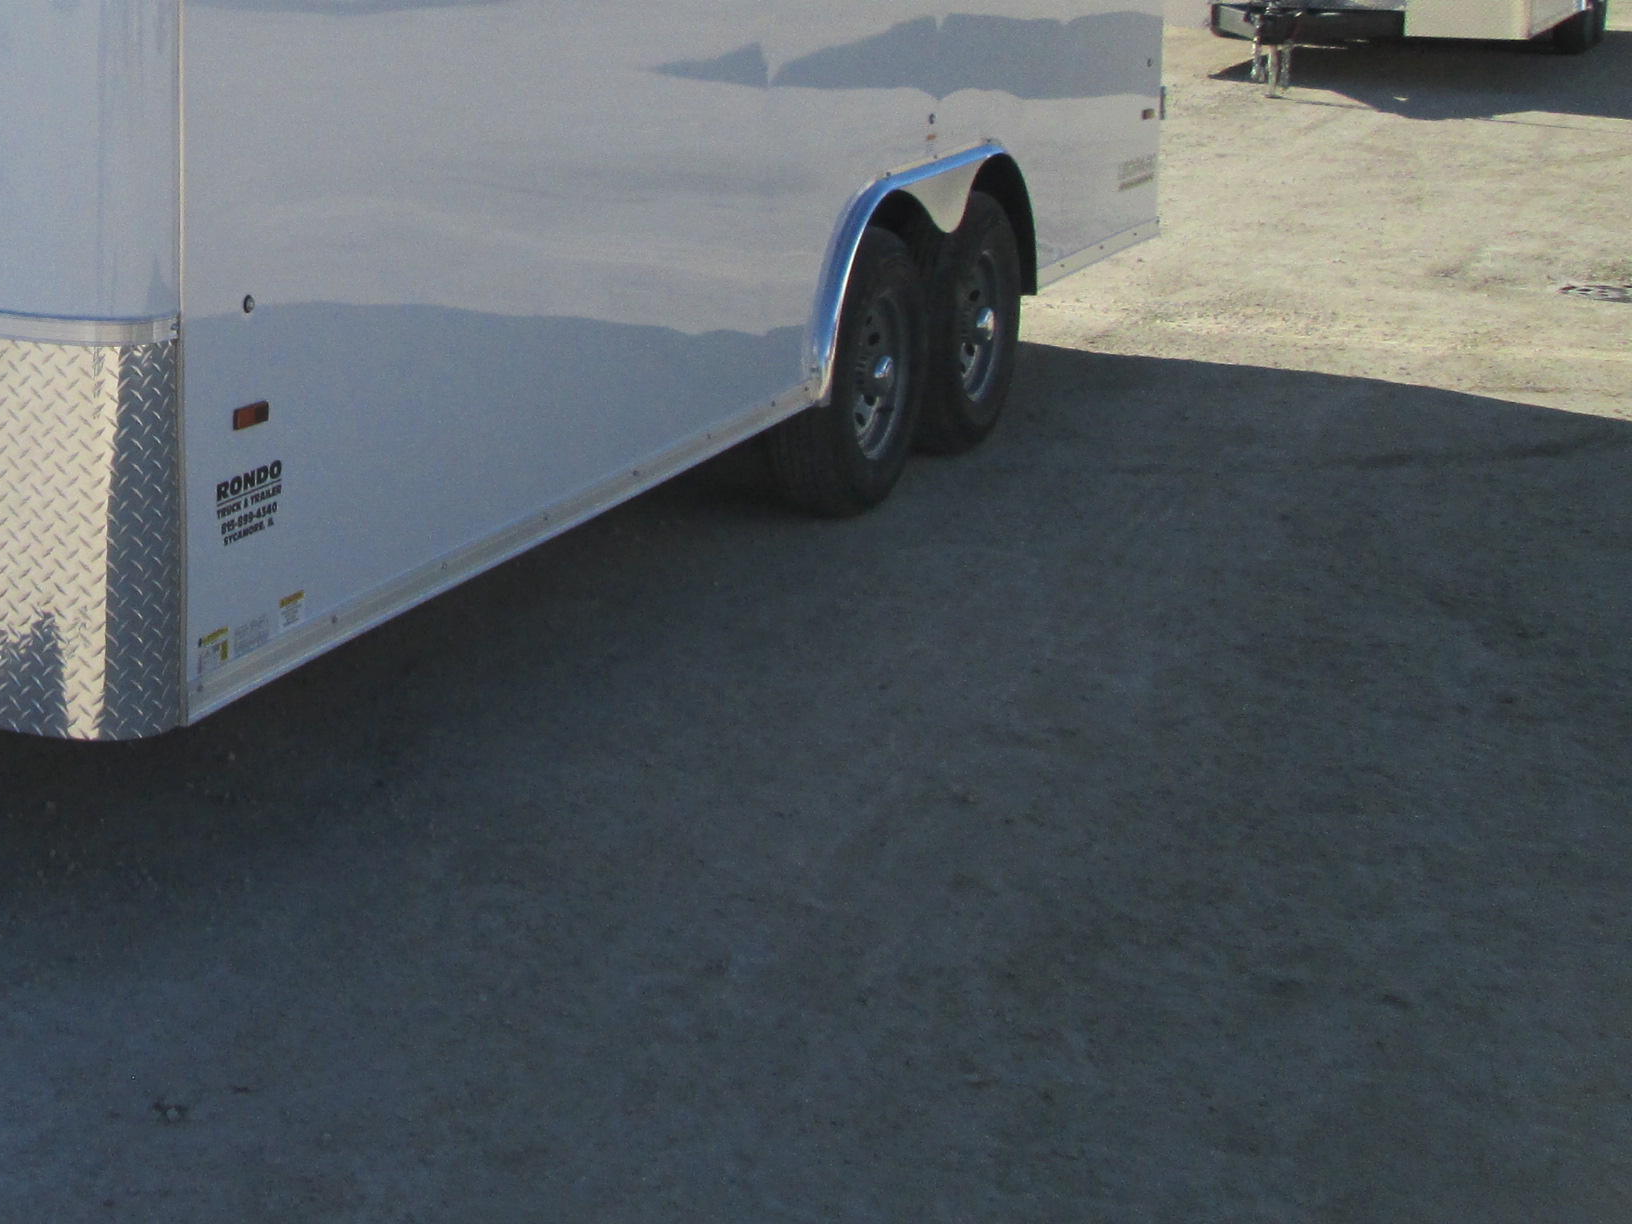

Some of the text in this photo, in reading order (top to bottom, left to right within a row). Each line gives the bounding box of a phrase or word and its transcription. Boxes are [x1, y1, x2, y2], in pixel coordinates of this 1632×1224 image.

[216, 459, 282, 502] RONDO
[216, 500, 242, 520] TRUCK
[250, 484, 282, 506] TRAILER
